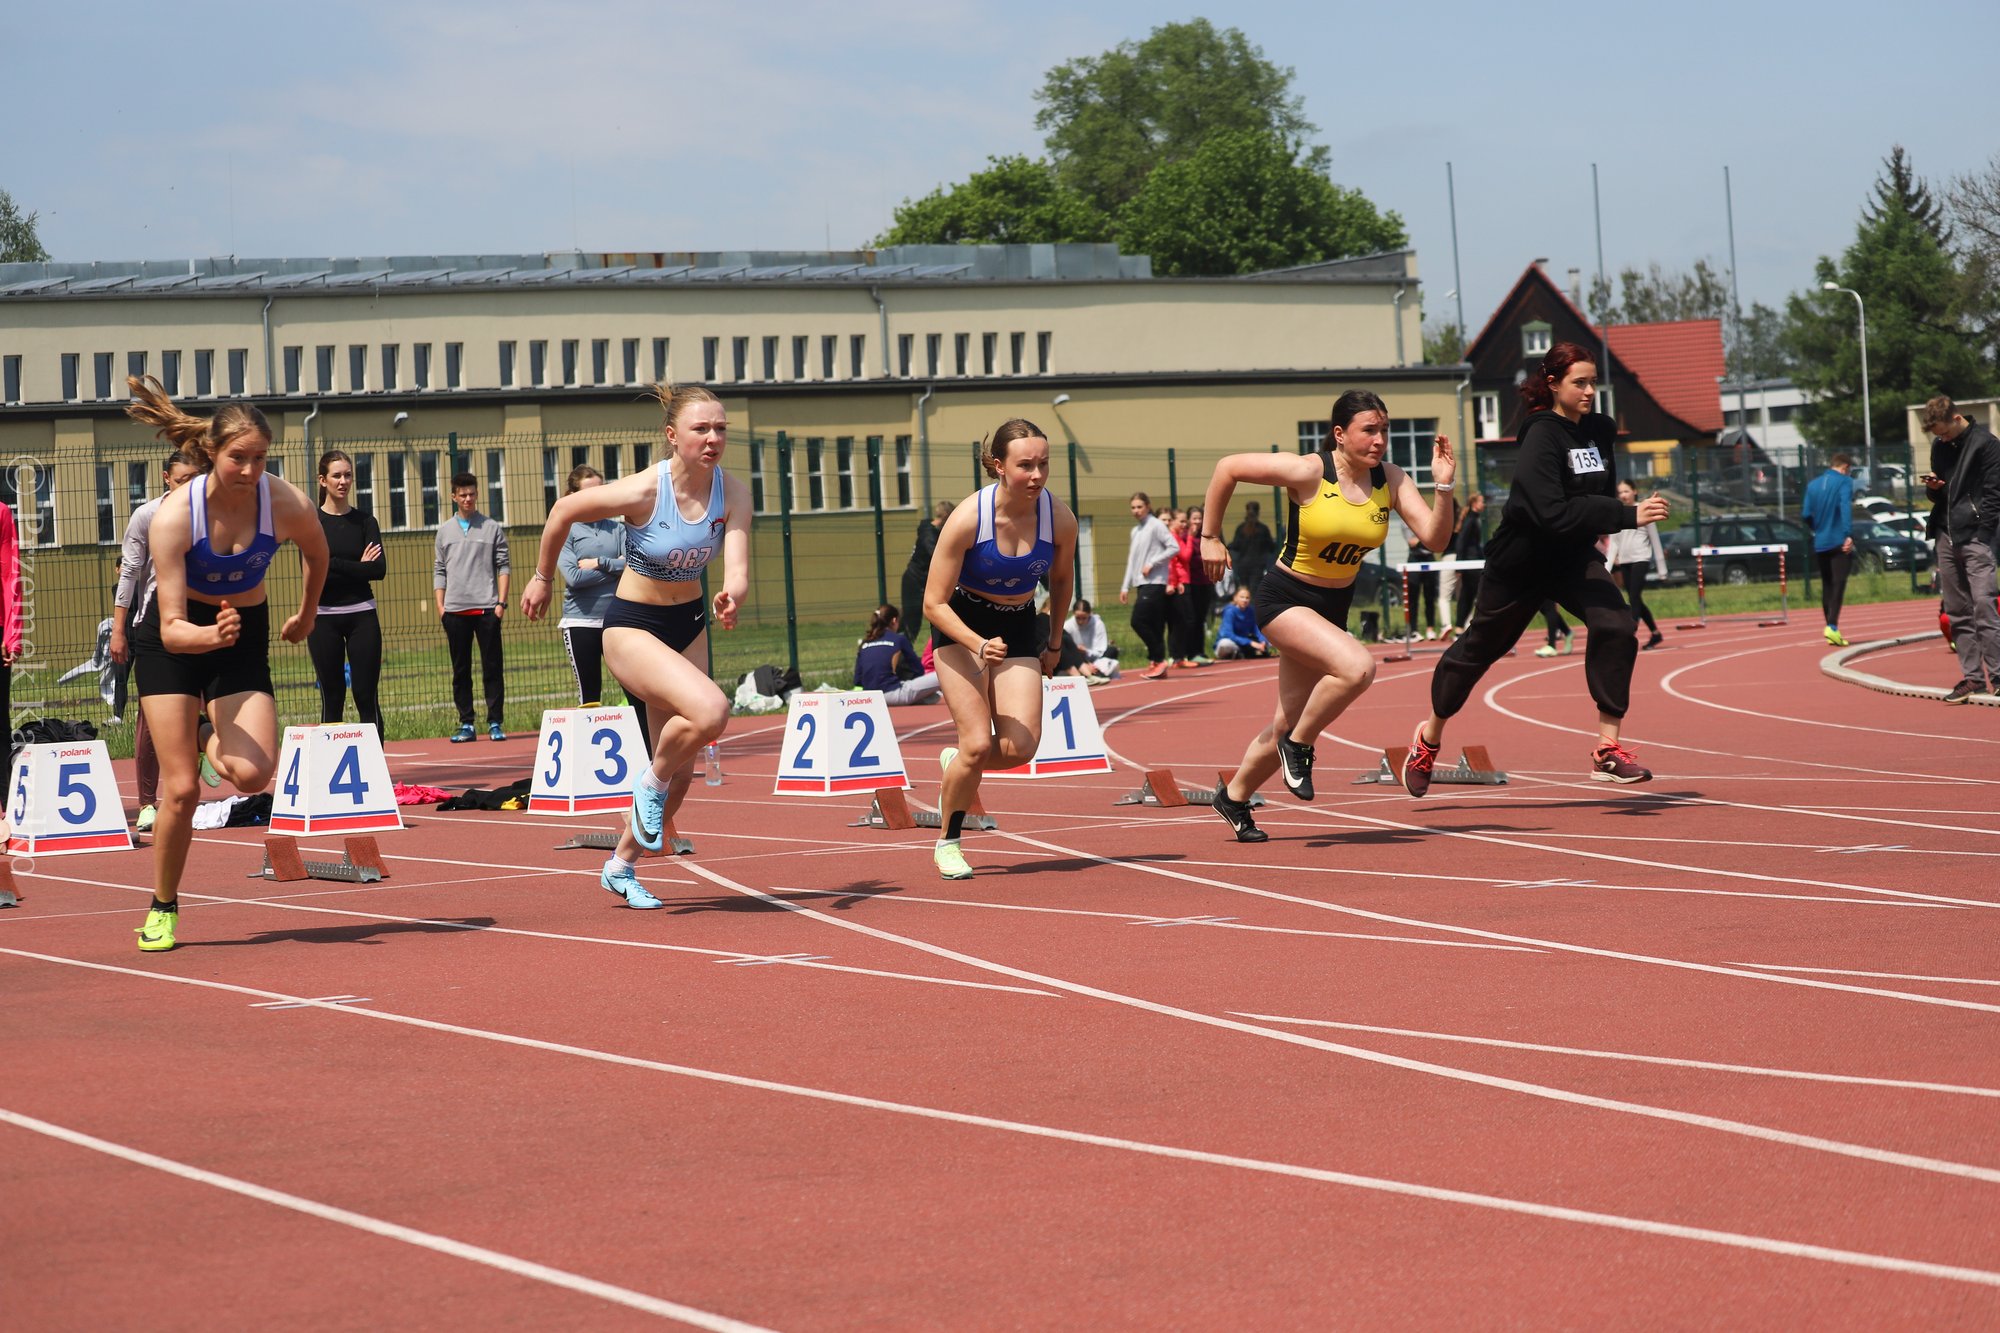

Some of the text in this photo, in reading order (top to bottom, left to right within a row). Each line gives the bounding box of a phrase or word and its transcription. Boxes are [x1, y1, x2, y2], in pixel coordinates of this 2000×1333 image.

[1575, 452, 1599, 468] 155
[665, 546, 712, 569] 367
[847, 697, 873, 706] polanik
[1051, 682, 1077, 692] polanik
[333, 730, 364, 741] polanik
[594, 713, 623, 723] polanik
[792, 713, 816, 769] 2
[844, 711, 880, 768] 2
[1051, 696, 1076, 750] 1
[60, 748, 92, 758] polanik
[283, 747, 301, 807] 4
[328, 745, 369, 805] 4
[544, 730, 563, 788] 3
[591, 728, 628, 785] 3
[14, 765, 29, 826] 5
[58, 762, 97, 825] 5
